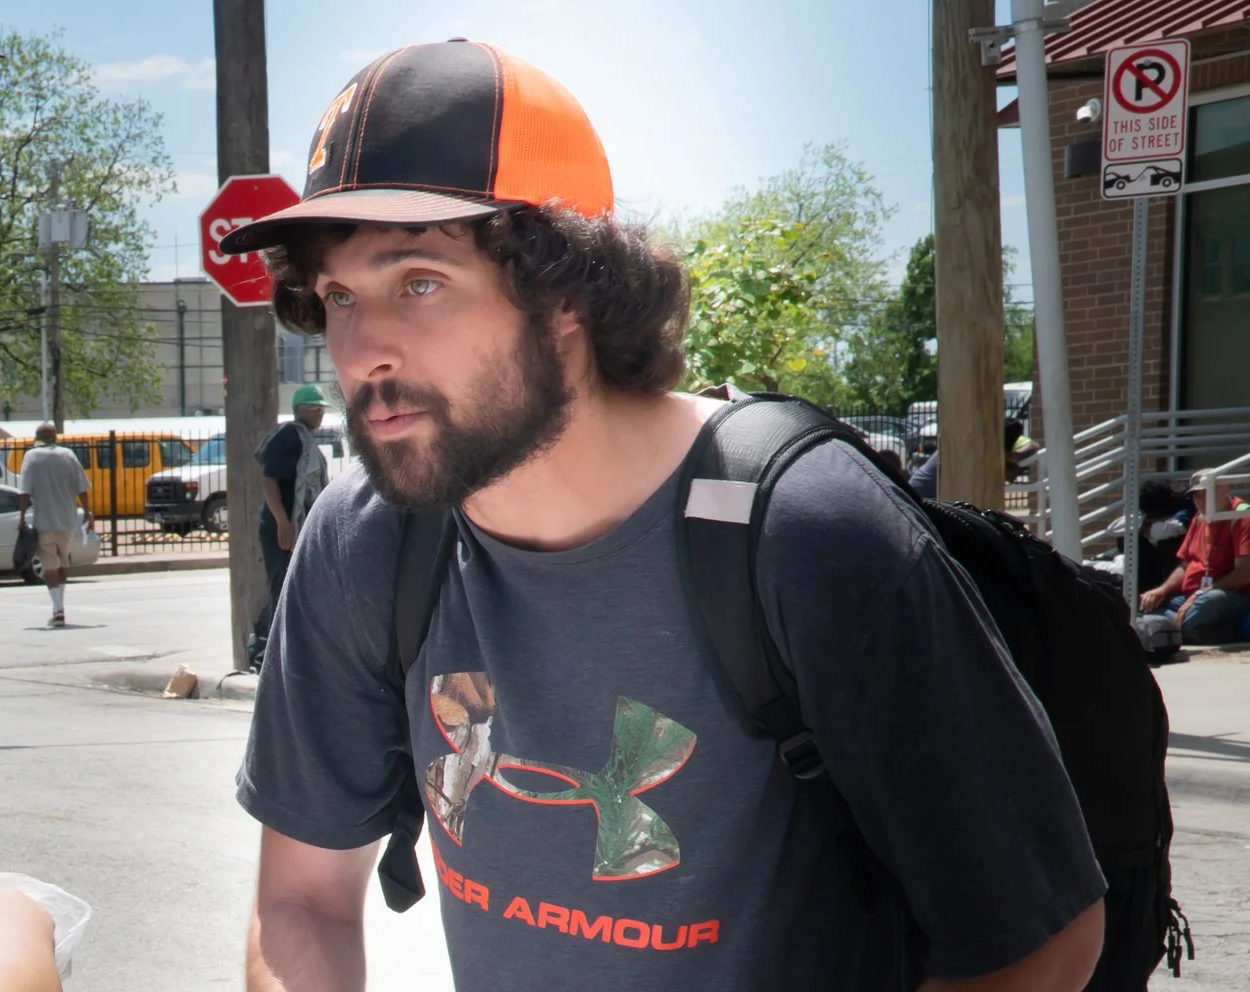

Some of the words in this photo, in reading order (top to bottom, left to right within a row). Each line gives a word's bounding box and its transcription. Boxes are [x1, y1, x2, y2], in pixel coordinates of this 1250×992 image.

[1113, 119, 1142, 134] THIS
[1148, 115, 1178, 131] SIDE
[1109, 138, 1124, 153] OF
[1131, 132, 1180, 150] STREET
[503, 896, 720, 951] ARMOUR
